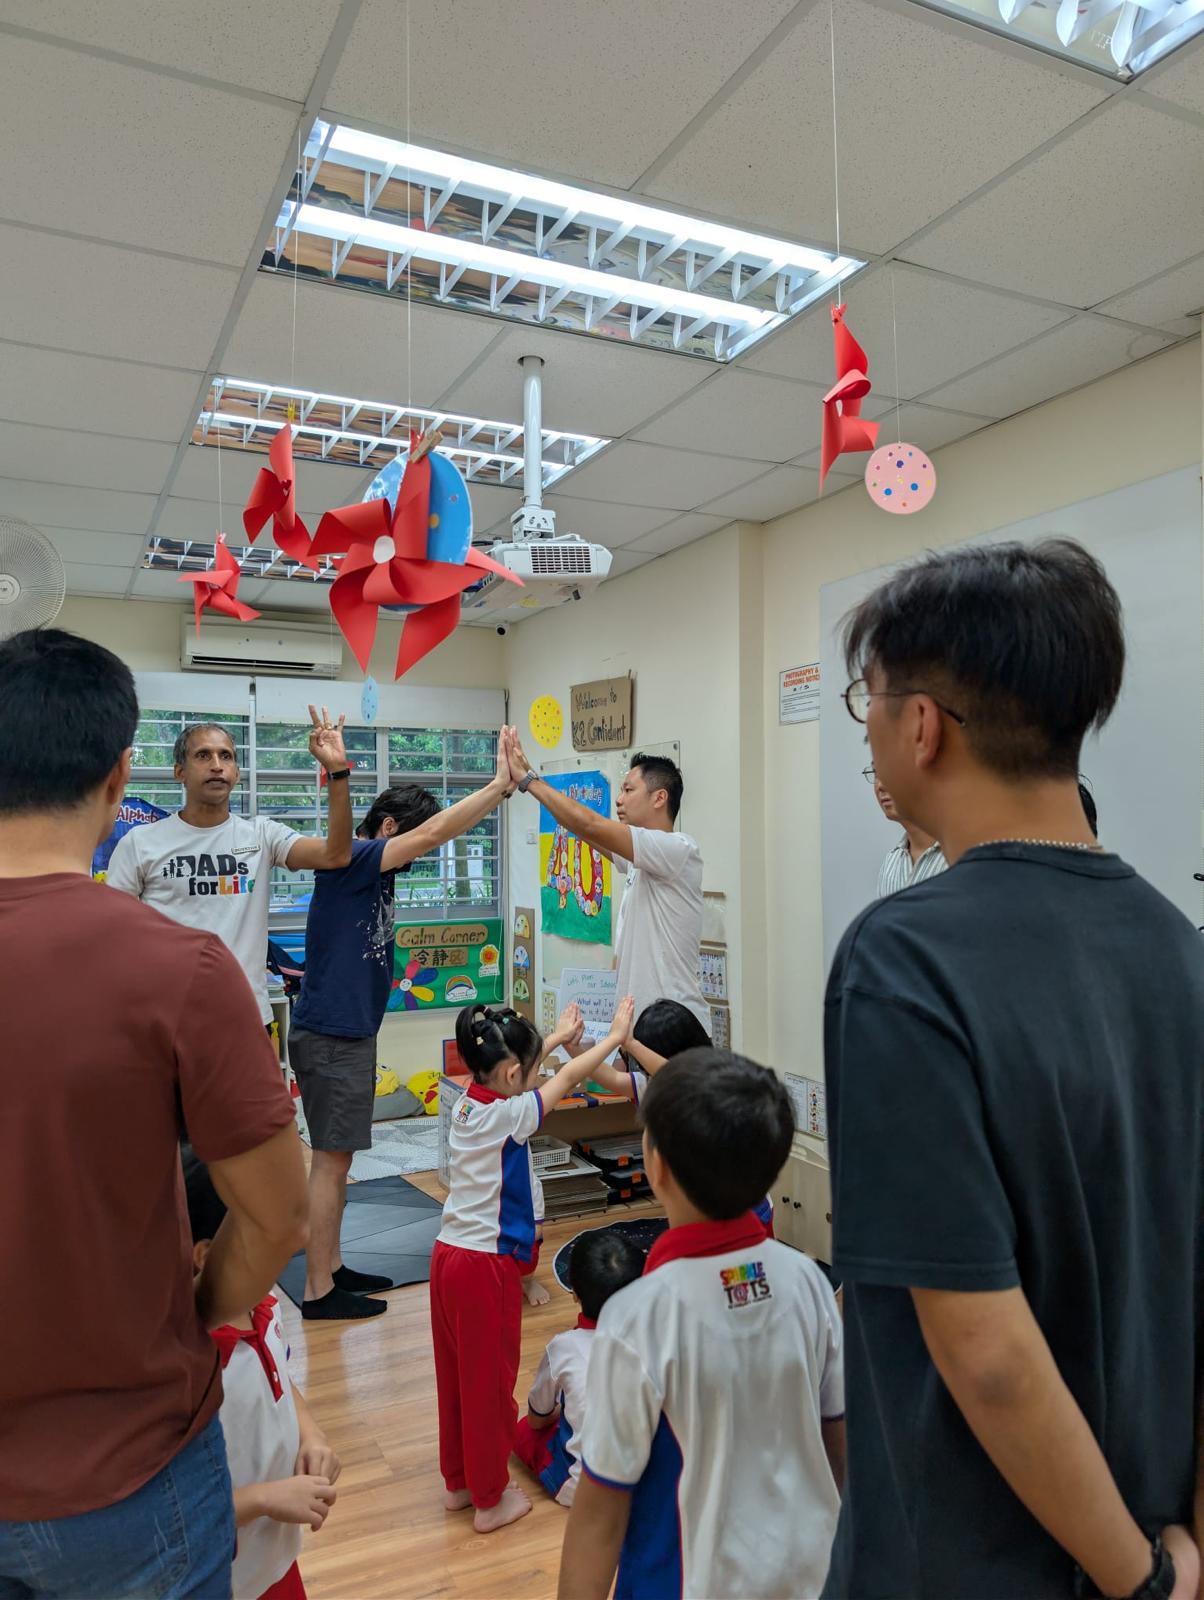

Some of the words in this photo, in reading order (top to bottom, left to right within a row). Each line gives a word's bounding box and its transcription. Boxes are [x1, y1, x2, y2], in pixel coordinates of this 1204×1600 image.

[610, 687, 617, 703] to
[401, 927, 435, 945] Calm
[441, 926, 485, 943] Corner
[724, 1278, 770, 1304] TOTS
